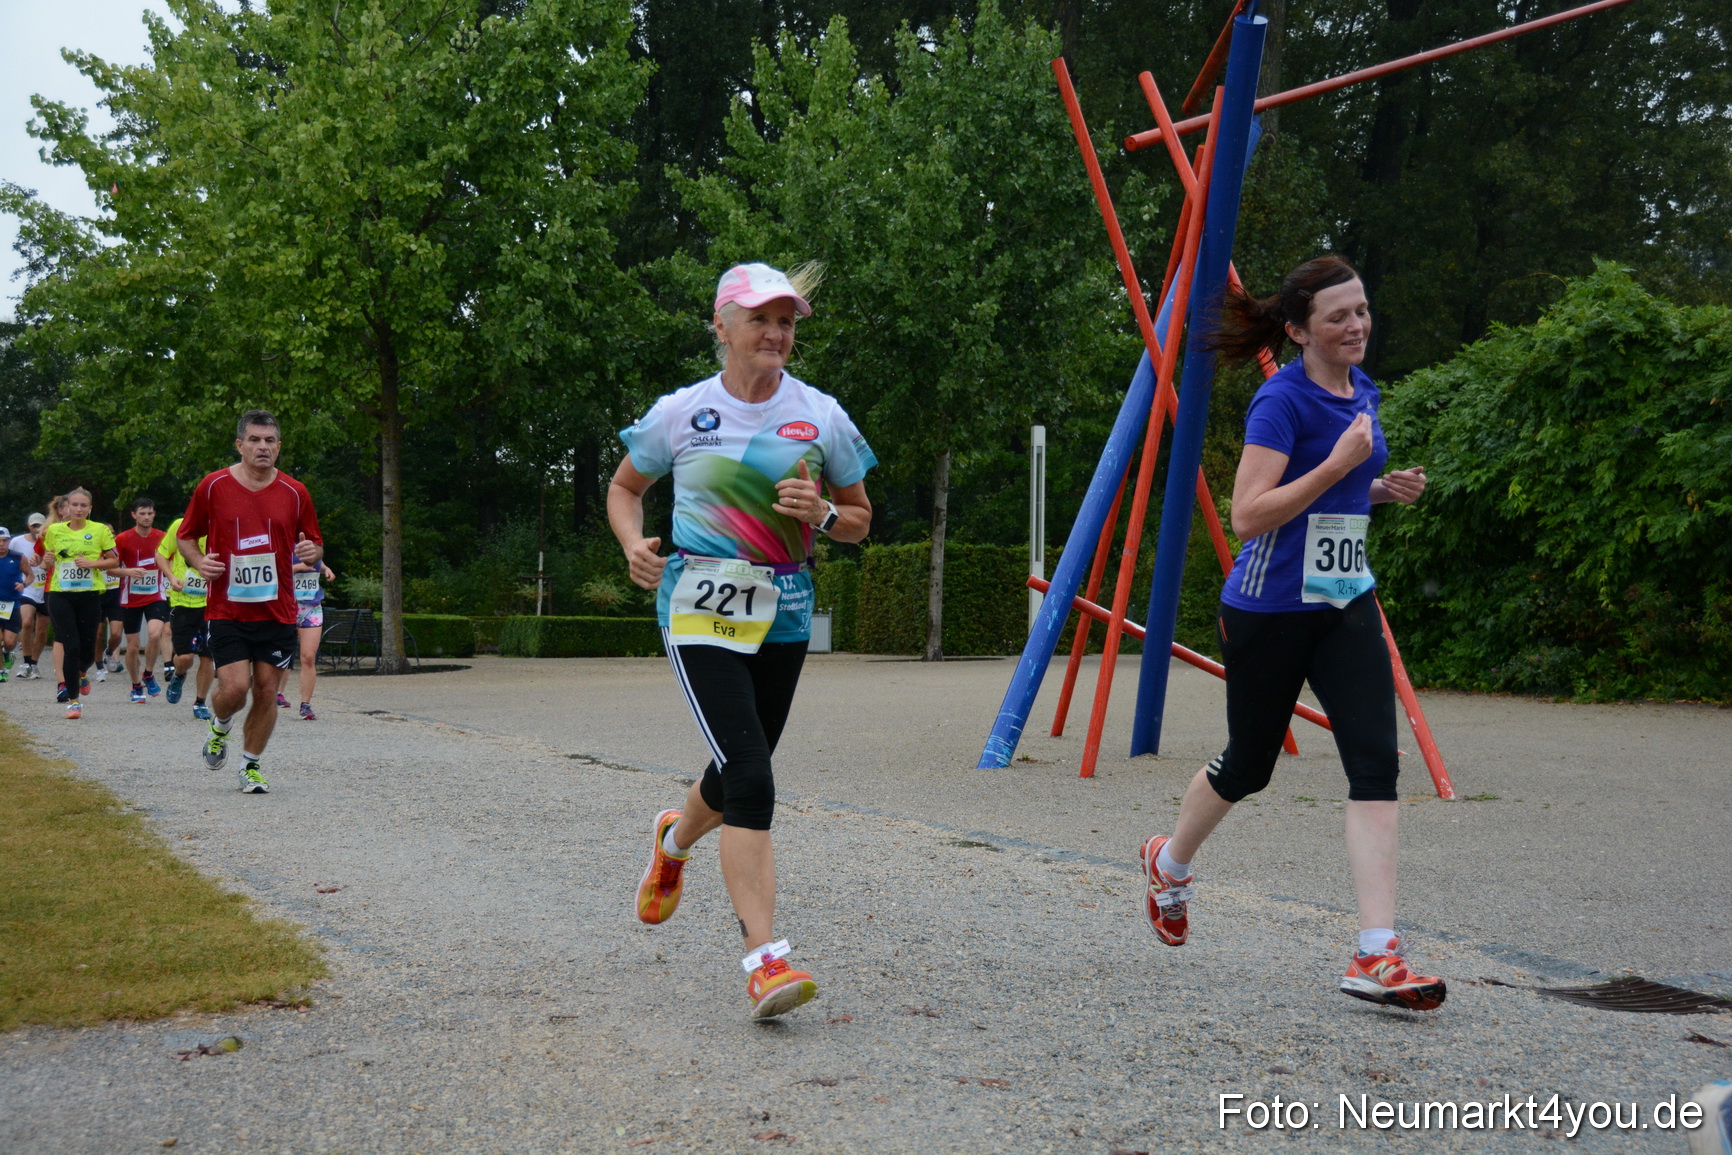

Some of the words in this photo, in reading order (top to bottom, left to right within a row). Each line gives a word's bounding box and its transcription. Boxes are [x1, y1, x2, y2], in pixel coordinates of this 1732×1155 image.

[782, 426, 815, 437] Hervis
[62, 568, 91, 580] 2892
[234, 565, 272, 585] 3076
[295, 579, 317, 590] 2469
[1335, 579, 1357, 595] Rita
[694, 579, 756, 616] 221
[713, 621, 735, 638] Eva
